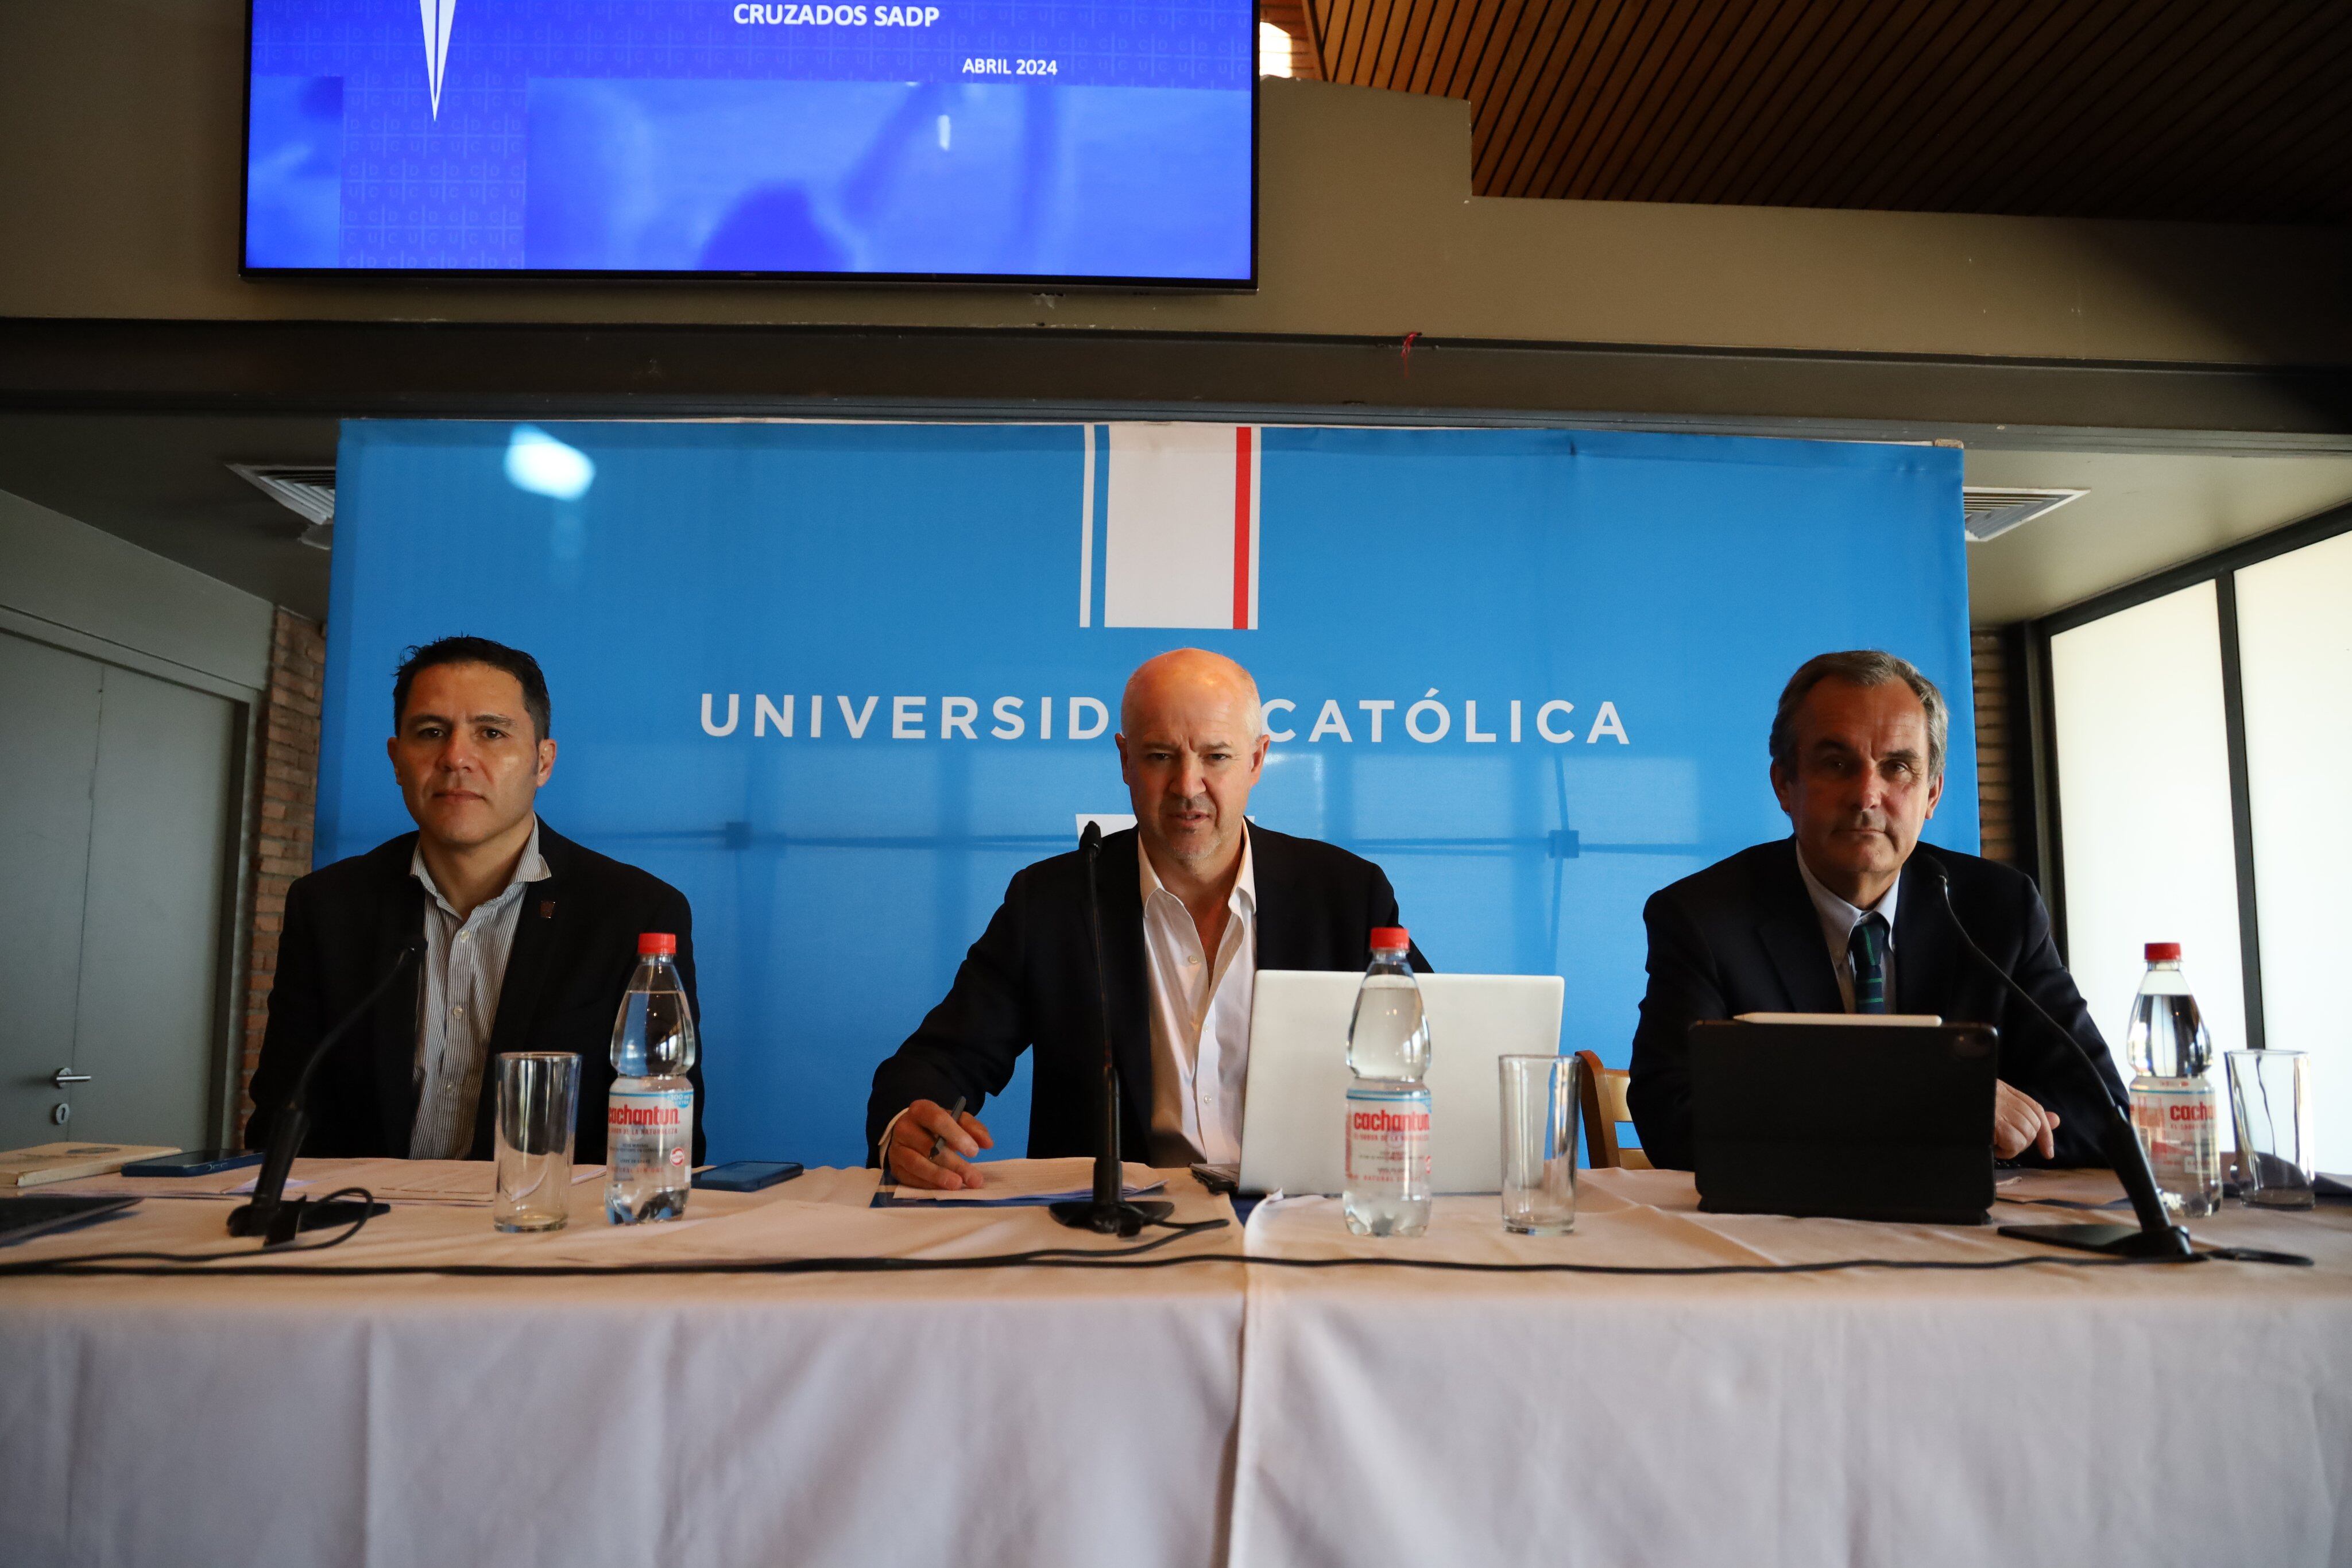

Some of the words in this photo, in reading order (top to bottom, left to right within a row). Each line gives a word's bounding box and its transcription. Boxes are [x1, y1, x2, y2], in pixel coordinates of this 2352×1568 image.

[733, 3, 867, 26] CRUZADOS
[874, 6, 939, 27] SADP
[962, 59, 1012, 74] ABRIL
[1016, 60, 1058, 75] 2024
[701, 693, 1109, 740] UNIVERSID
[1260, 687, 1630, 745] CATÓLICA
